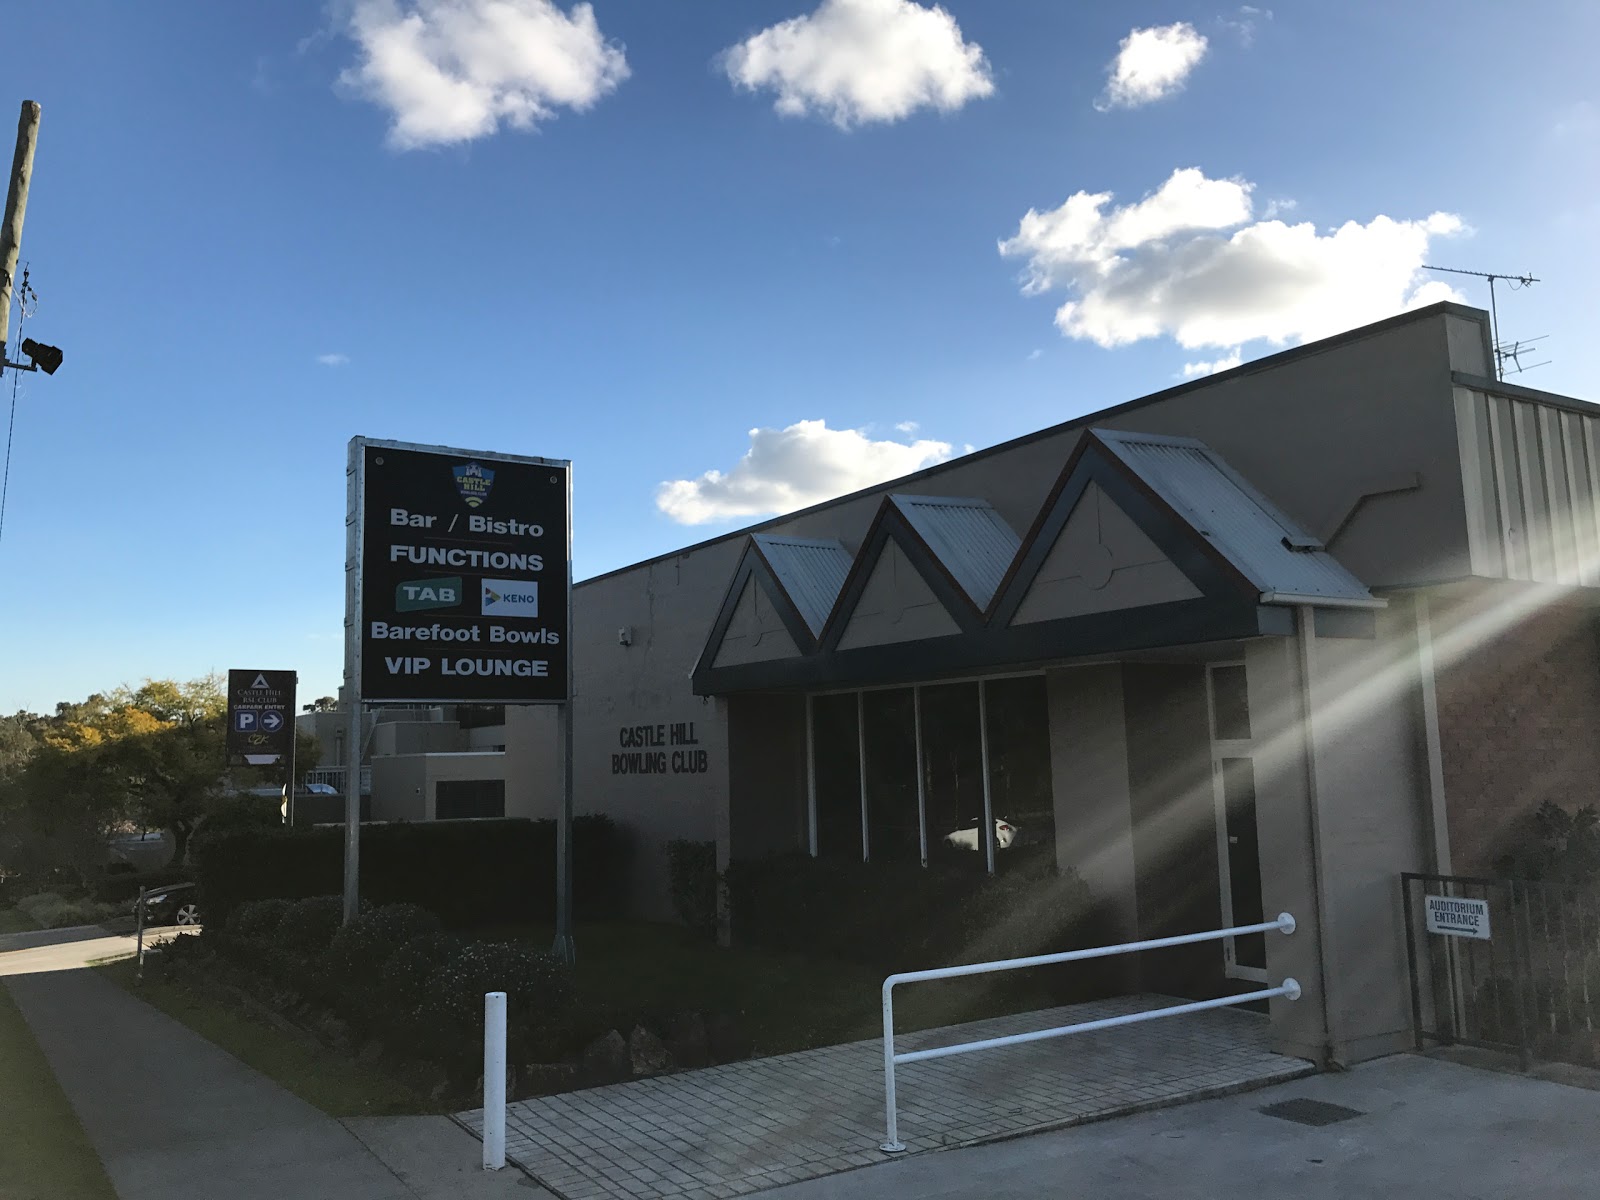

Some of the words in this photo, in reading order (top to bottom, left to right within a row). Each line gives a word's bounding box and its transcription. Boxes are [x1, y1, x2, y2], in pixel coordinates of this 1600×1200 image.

[456, 476, 491, 486] CASTLE
[463, 482, 486, 492] HILL
[390, 508, 437, 528] Bar
[448, 514, 459, 533] /
[469, 515, 544, 537] Bistro
[390, 545, 544, 572] FUNCTIONS
[402, 586, 456, 602] TAB
[503, 594, 535, 604] KENO
[371, 622, 481, 642] Barefoot
[489, 626, 560, 645] Bowls
[385, 657, 431, 675] VIP
[441, 658, 549, 677] LOUNGE
[240, 713, 254, 729] P
[620, 724, 666, 748] CASTLE
[670, 722, 699, 745] HILL
[612, 752, 667, 775] BOWLING
[671, 750, 708, 774] CLUB
[1429, 899, 1484, 915] AUDITORIUM
[1434, 911, 1480, 927] ENTRANCE
